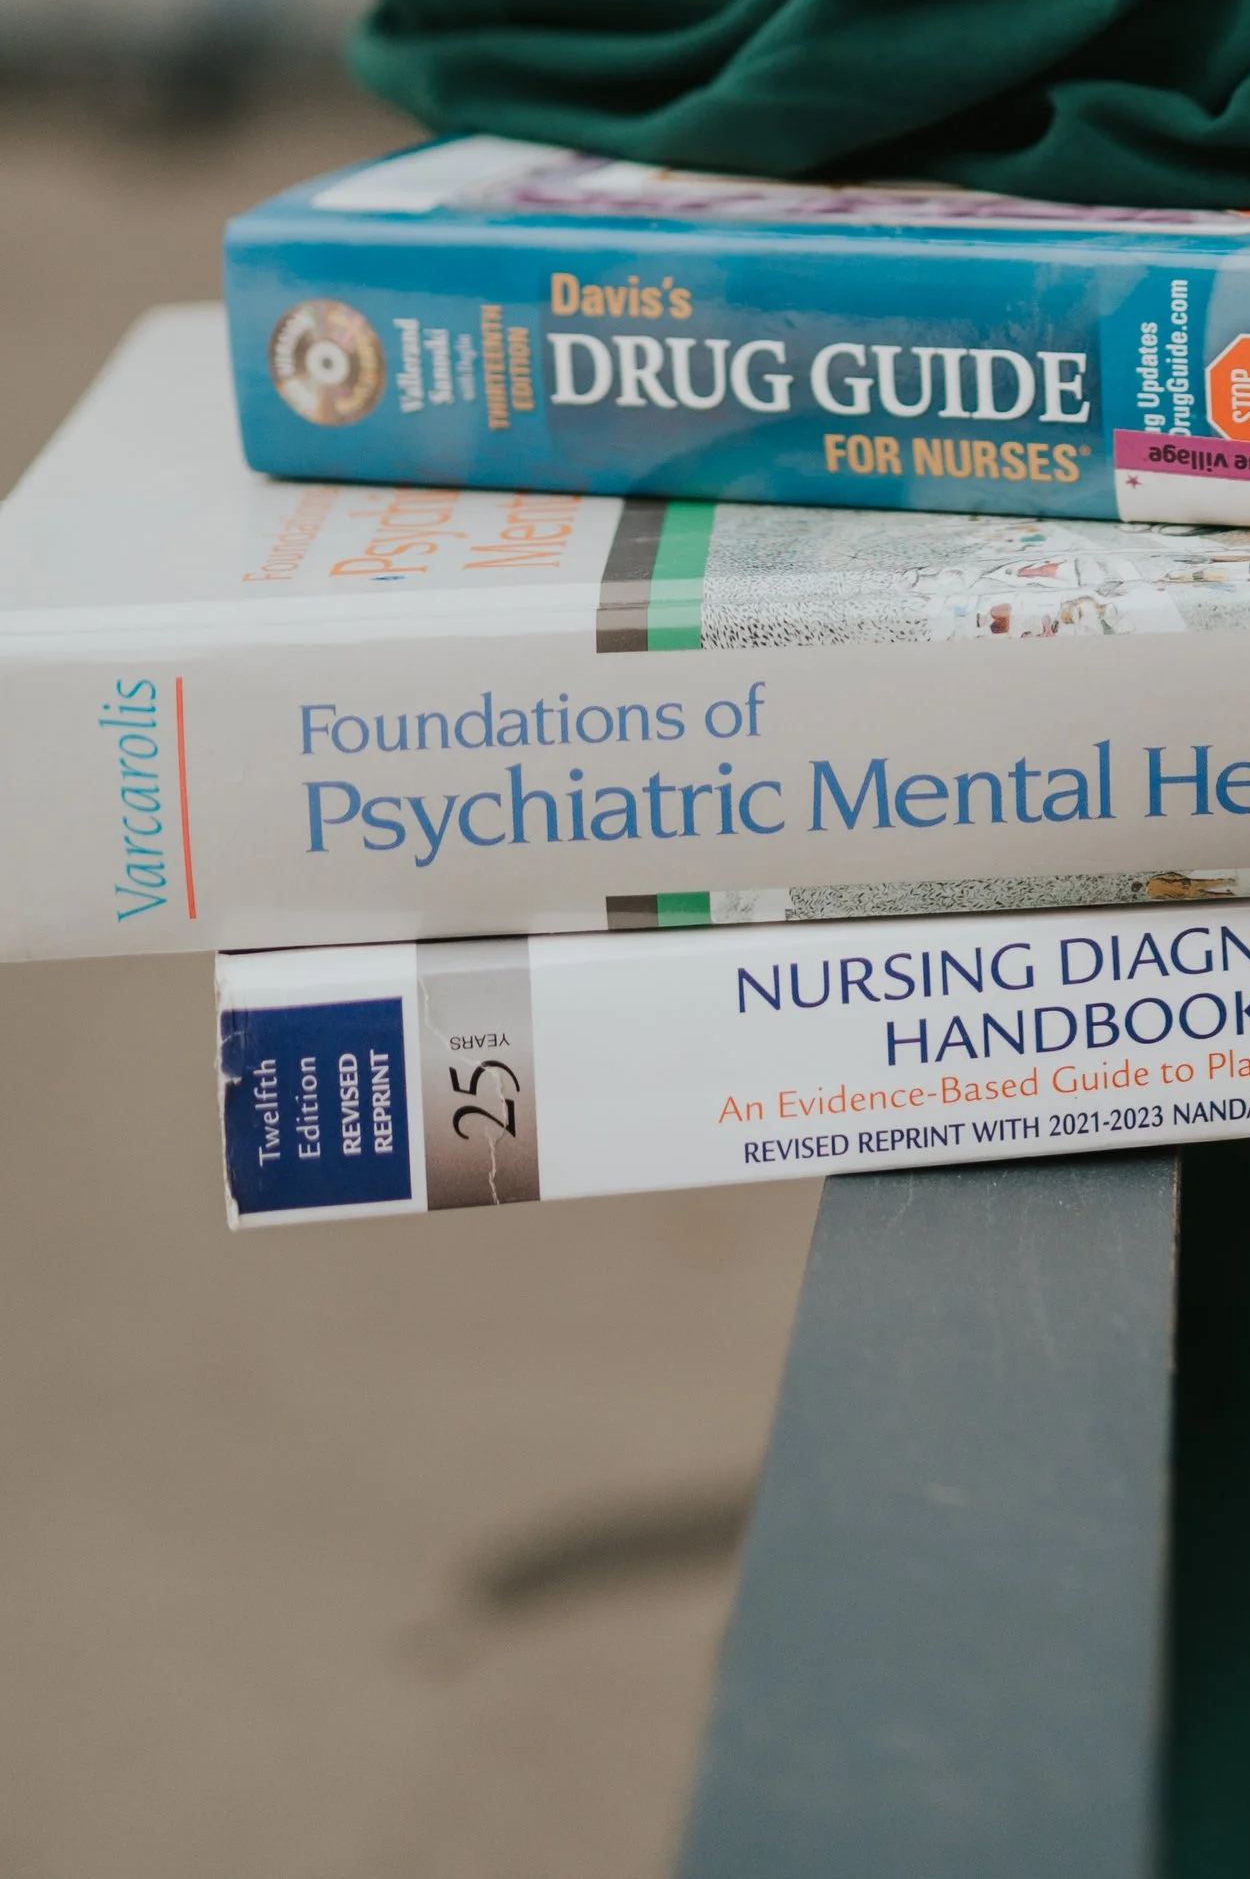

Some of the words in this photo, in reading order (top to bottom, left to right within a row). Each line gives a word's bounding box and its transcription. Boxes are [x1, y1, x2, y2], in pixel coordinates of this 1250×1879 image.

[551, 272, 693, 319] Davis's
[507, 326, 535, 412] EDITION
[546, 332, 794, 412] DRUG
[810, 342, 1091, 423] GUIDE
[1136, 321, 1166, 409] Updates
[823, 433, 902, 475] FOR
[1148, 445, 1229, 471] village
[299, 692, 686, 755] Foundations
[703, 680, 767, 739] of
[100, 678, 168, 923] Varcarolis
[303, 762, 787, 868] Psychiatric
[806, 739, 1118, 831] Mental
[736, 942, 1035, 1014] NURSING
[449, 1032, 511, 1051] YEARS
[253, 1058, 281, 1167] Twelfth
[294, 1056, 321, 1159] Edition
[338, 1052, 362, 1157] REVISED
[369, 1048, 393, 1155] REPRINT
[449, 1060, 521, 1141] 25
[719, 1096, 764, 1124] An
[778, 1067, 1039, 1119] Evidence-Based
[1052, 1058, 1150, 1094] Guide
[1161, 1061, 1195, 1084] to
[744, 1133, 849, 1164] REVISED
[858, 1122, 966, 1154] REPRINT
[972, 1116, 1041, 1143] WITH
[1049, 1104, 1164, 1138] 2021-2023
